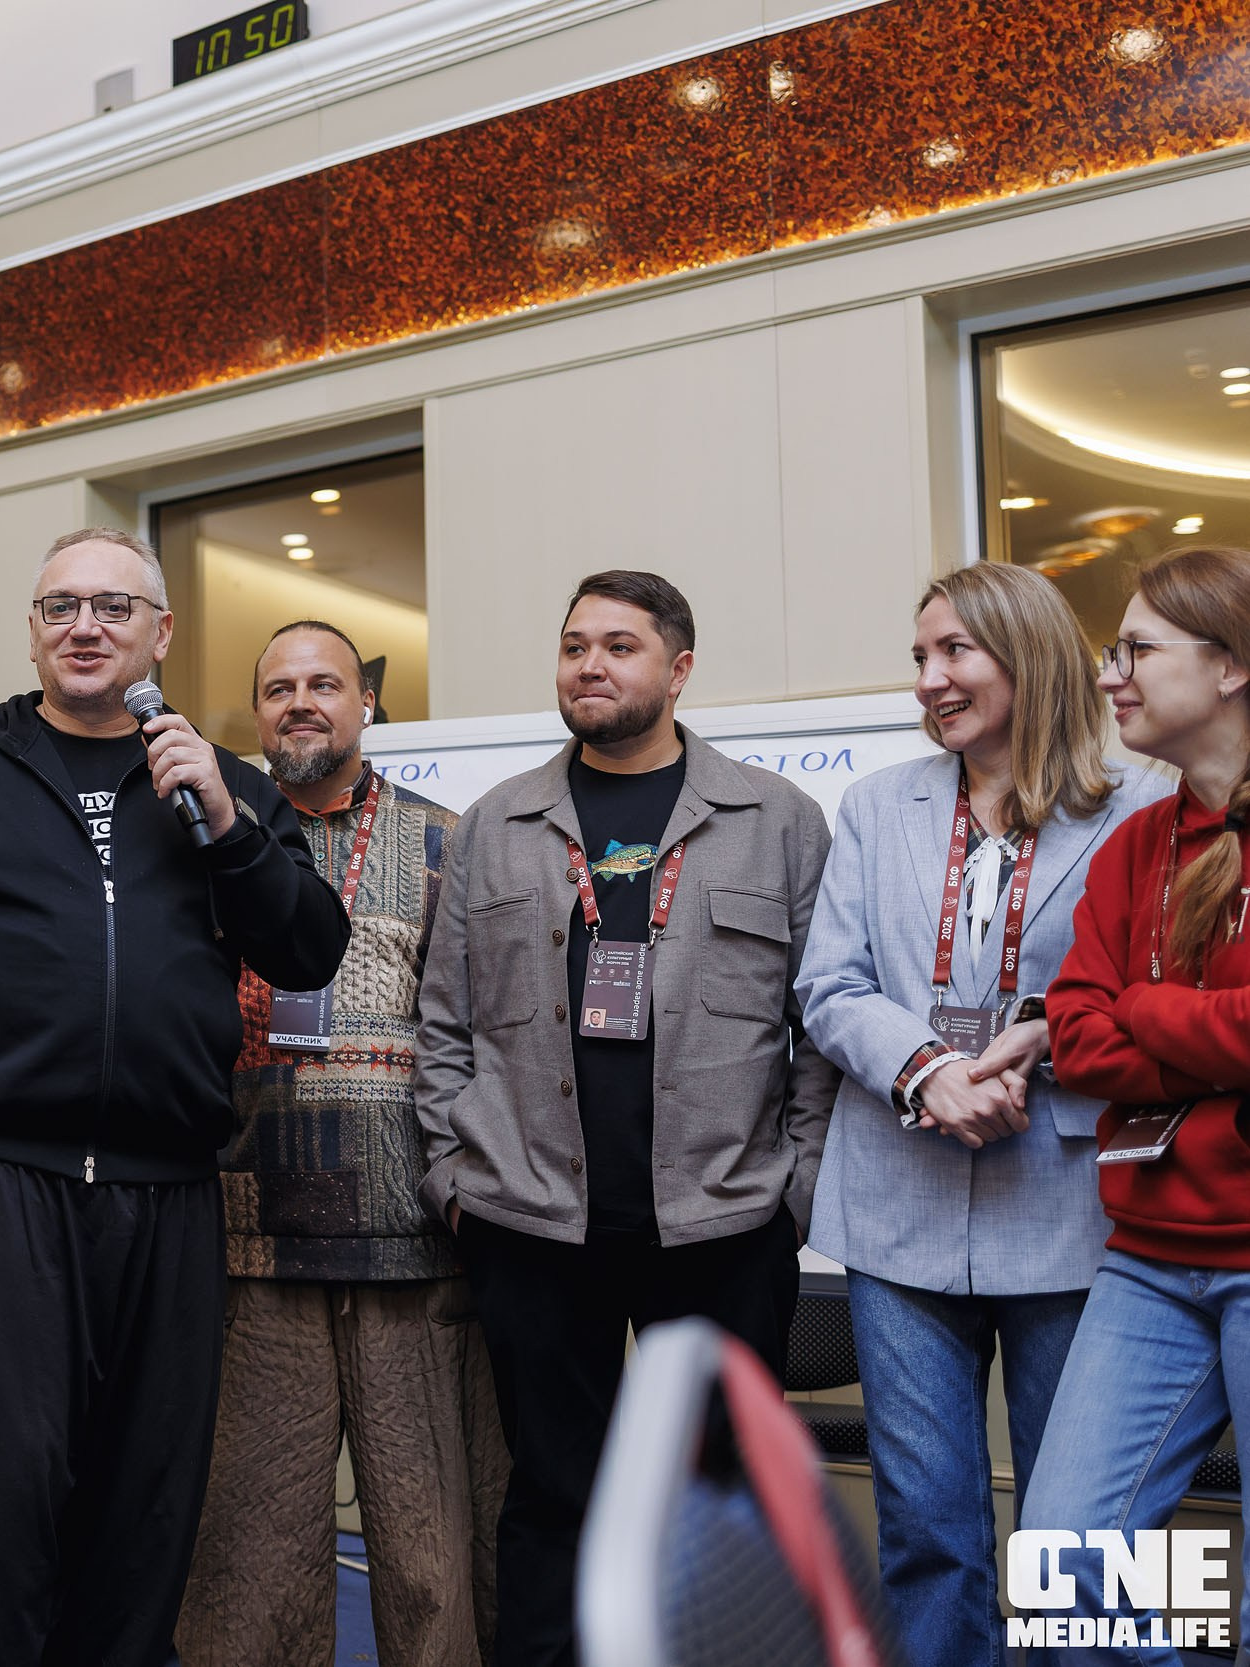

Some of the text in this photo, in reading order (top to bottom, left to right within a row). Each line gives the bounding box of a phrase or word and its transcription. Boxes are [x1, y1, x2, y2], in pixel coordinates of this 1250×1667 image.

[243, 3, 295, 59] 50
[361, 812, 373, 831] 2026
[954, 816, 967, 838] 2026
[1021, 838, 1034, 859] 2026
[351, 852, 362, 871] БКФ
[947, 866, 960, 887] БКФ
[658, 888, 672, 910] БКФ
[1011, 888, 1024, 911] БКФ
[941, 916, 953, 941] 2026
[1004, 947, 1016, 972] БКФ
[630, 943, 646, 1038] sapere aude sapere aude
[989, 1011, 998, 1034] sapere
[275, 1035, 323, 1045] УЧАСТНИК
[1105, 1148, 1155, 1159] УЧАСТНИК
